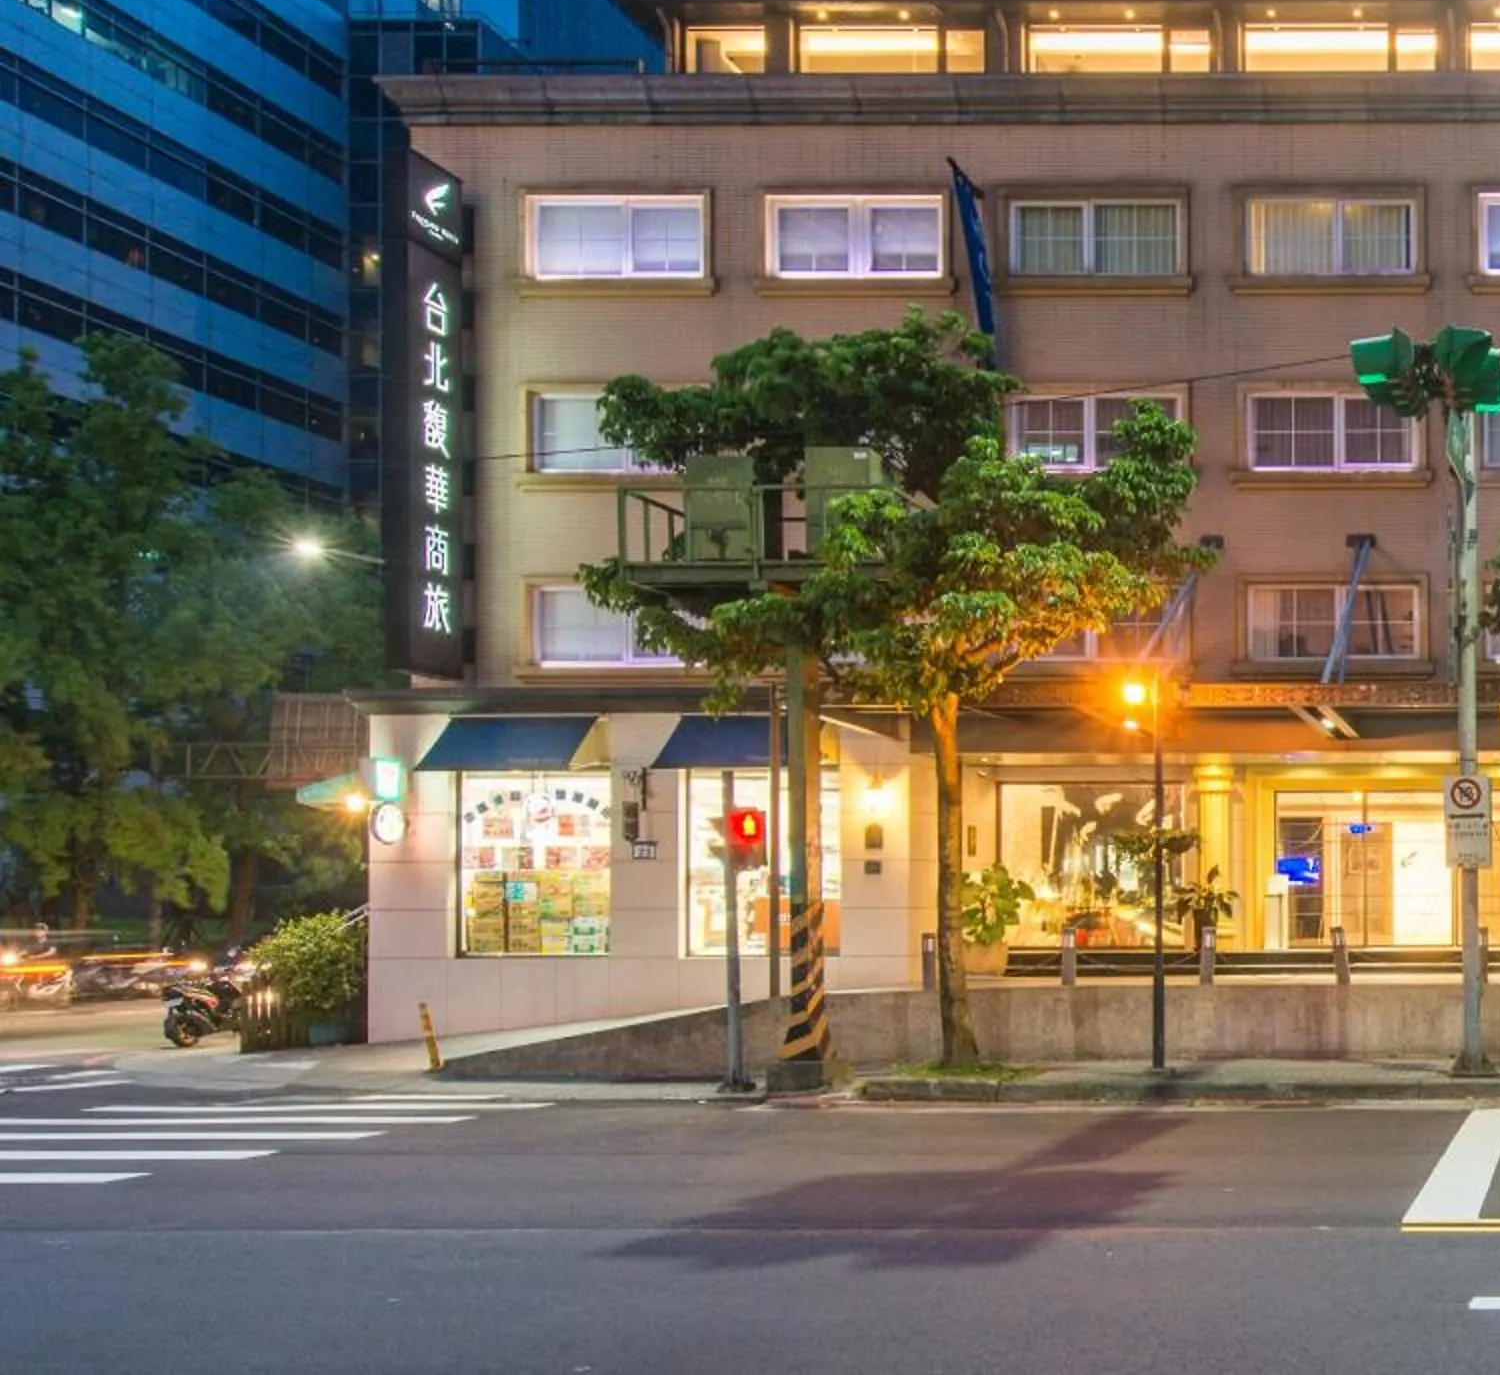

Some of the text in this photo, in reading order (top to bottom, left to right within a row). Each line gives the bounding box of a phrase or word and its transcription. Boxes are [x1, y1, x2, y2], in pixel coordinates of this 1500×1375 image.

[423, 282, 452, 635] 台北馥華商旅
